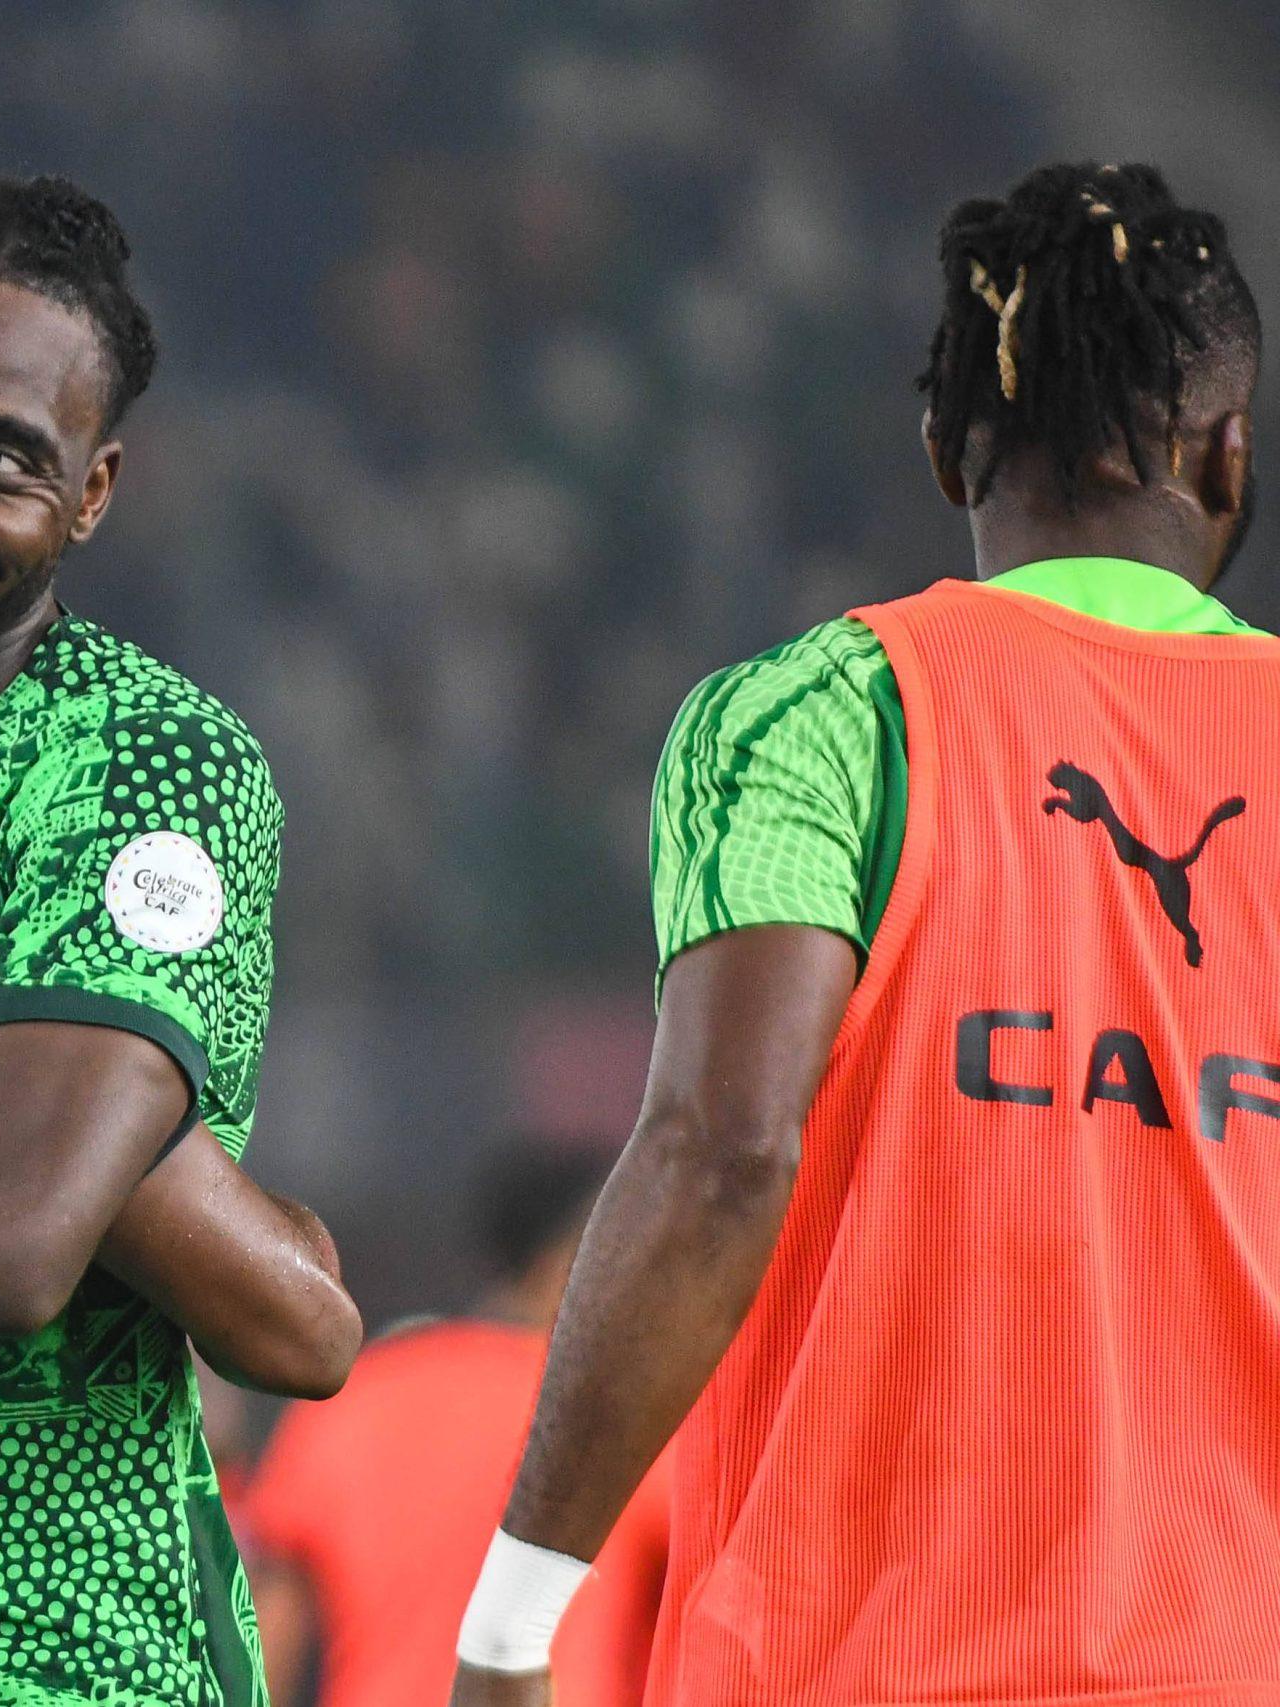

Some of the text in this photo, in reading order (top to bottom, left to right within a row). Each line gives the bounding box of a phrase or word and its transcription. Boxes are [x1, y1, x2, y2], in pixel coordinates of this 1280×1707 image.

[133, 869, 203, 898] Celebrate
[145, 883, 187, 905] Africa
[145, 896, 180, 916] CAF
[956, 1008, 1280, 1143] CAF
